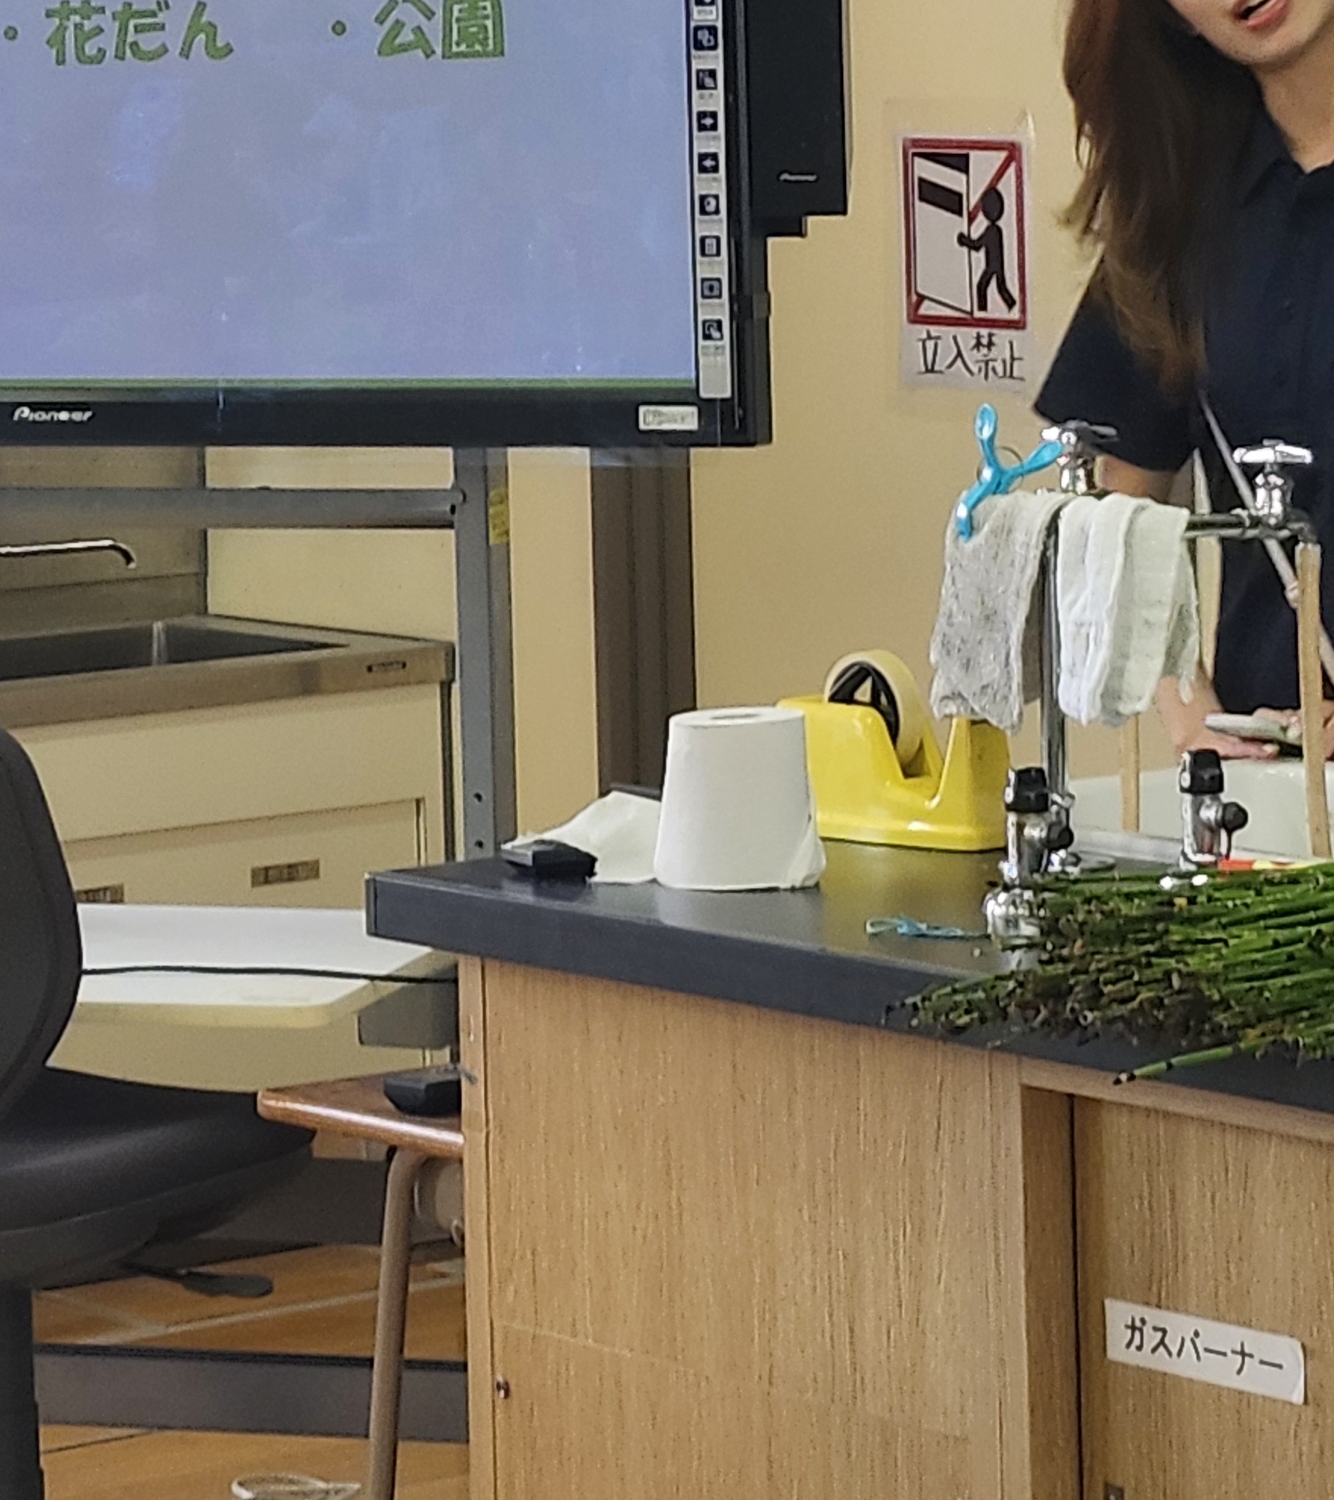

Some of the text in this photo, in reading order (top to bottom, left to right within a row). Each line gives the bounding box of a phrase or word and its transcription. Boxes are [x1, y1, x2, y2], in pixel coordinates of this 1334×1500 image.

[917, 329, 1025, 382] 立入禁止
[1124, 1314, 1284, 1376] ガスバーナー
